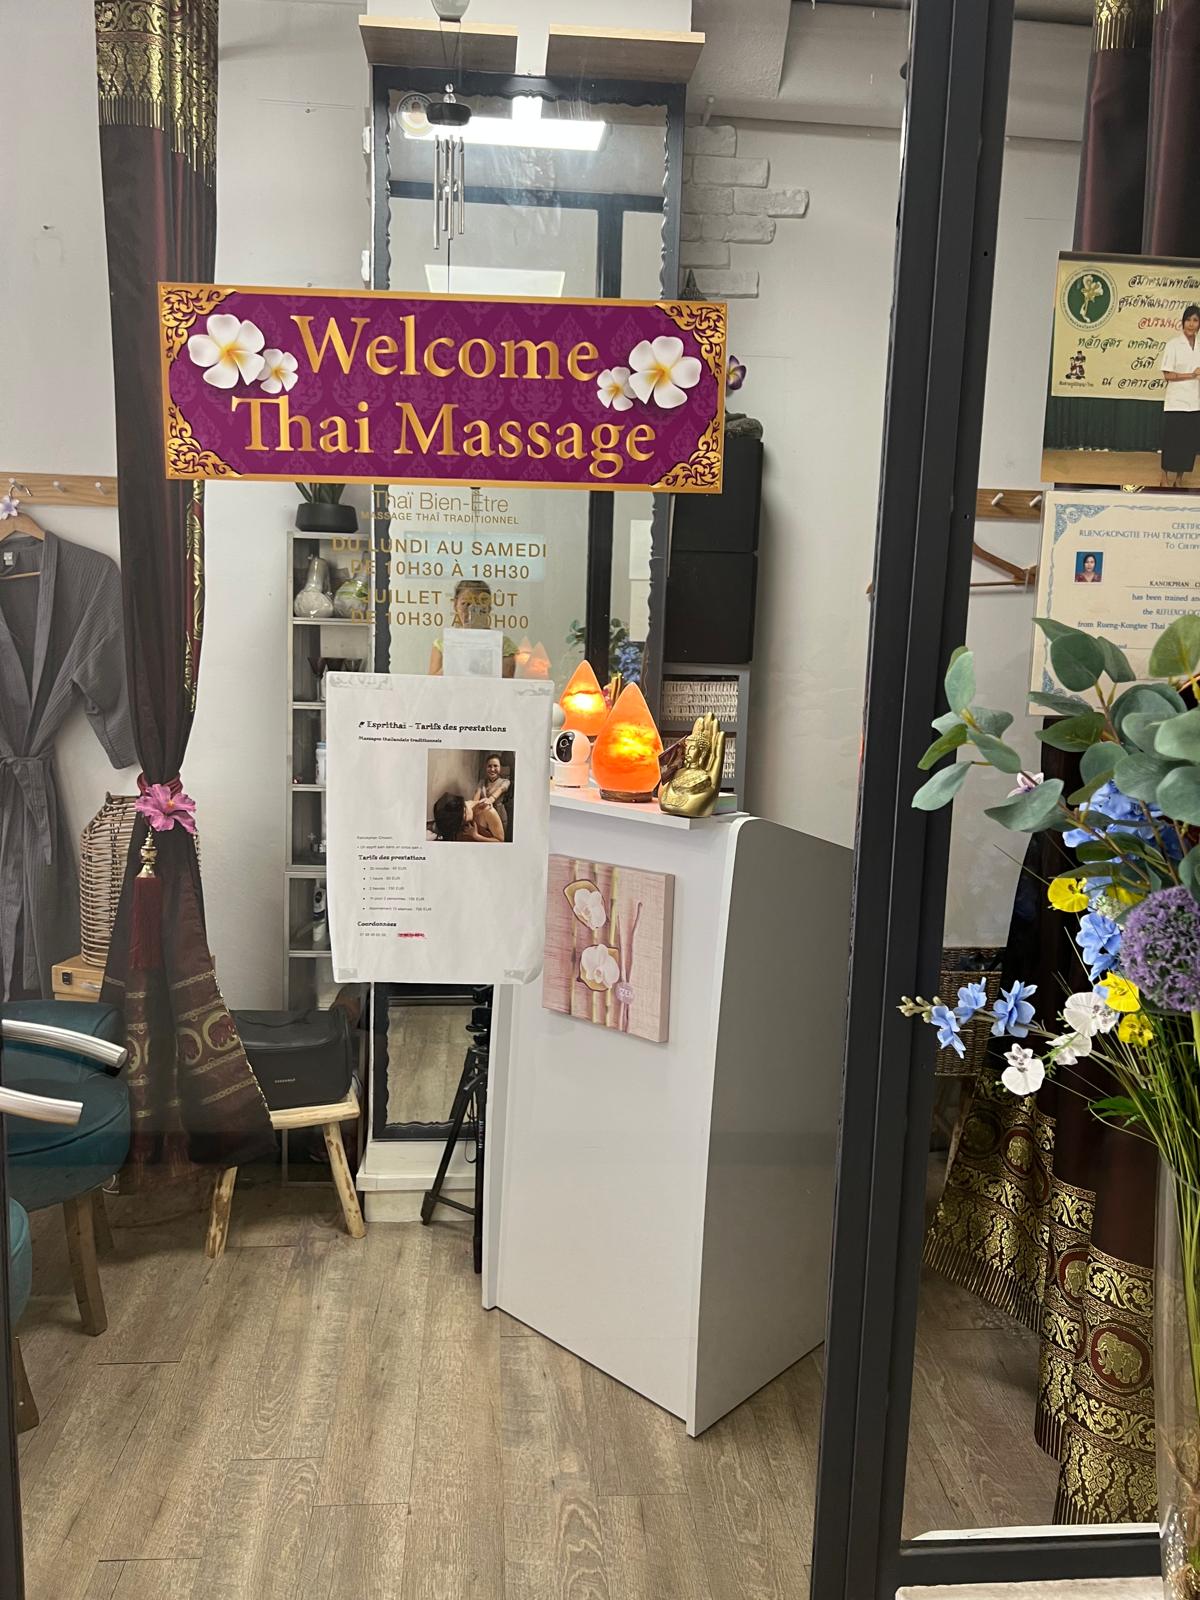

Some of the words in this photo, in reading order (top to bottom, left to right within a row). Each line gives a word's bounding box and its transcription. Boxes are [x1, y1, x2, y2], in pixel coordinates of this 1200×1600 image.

[290, 314, 599, 382] Welcome
[1131, 353, 1159, 370] วันที่
[231, 394, 370, 456] Thai
[398, 402, 656, 478] Massage
[372, 490, 413, 509] Thaï
[361, 511, 412, 520] MASSAGE
[444, 514, 520, 525] TRADITIONNEL
[1143, 531, 1160, 539] THAI
[332, 537, 360, 552] DU
[368, 538, 428, 554] LUNDI
[437, 540, 463, 555] AU
[472, 541, 546, 558] SAMEDI
[351, 560, 376, 575] DE
[385, 561, 443, 576] 10H30
[451, 559, 464, 577] À
[472, 564, 529, 579] 18H30
[362, 589, 442, 605] JUILLET
[1164, 594, 1188, 602] trained
[351, 608, 376, 624] DE
[385, 611, 443, 627] 10H30
[1142, 608, 1153, 616] the
[1150, 622, 1166, 630] Thai
[414, 722, 441, 731] Tarifs
[443, 723, 457, 731] des
[459, 723, 507, 733] prestations
